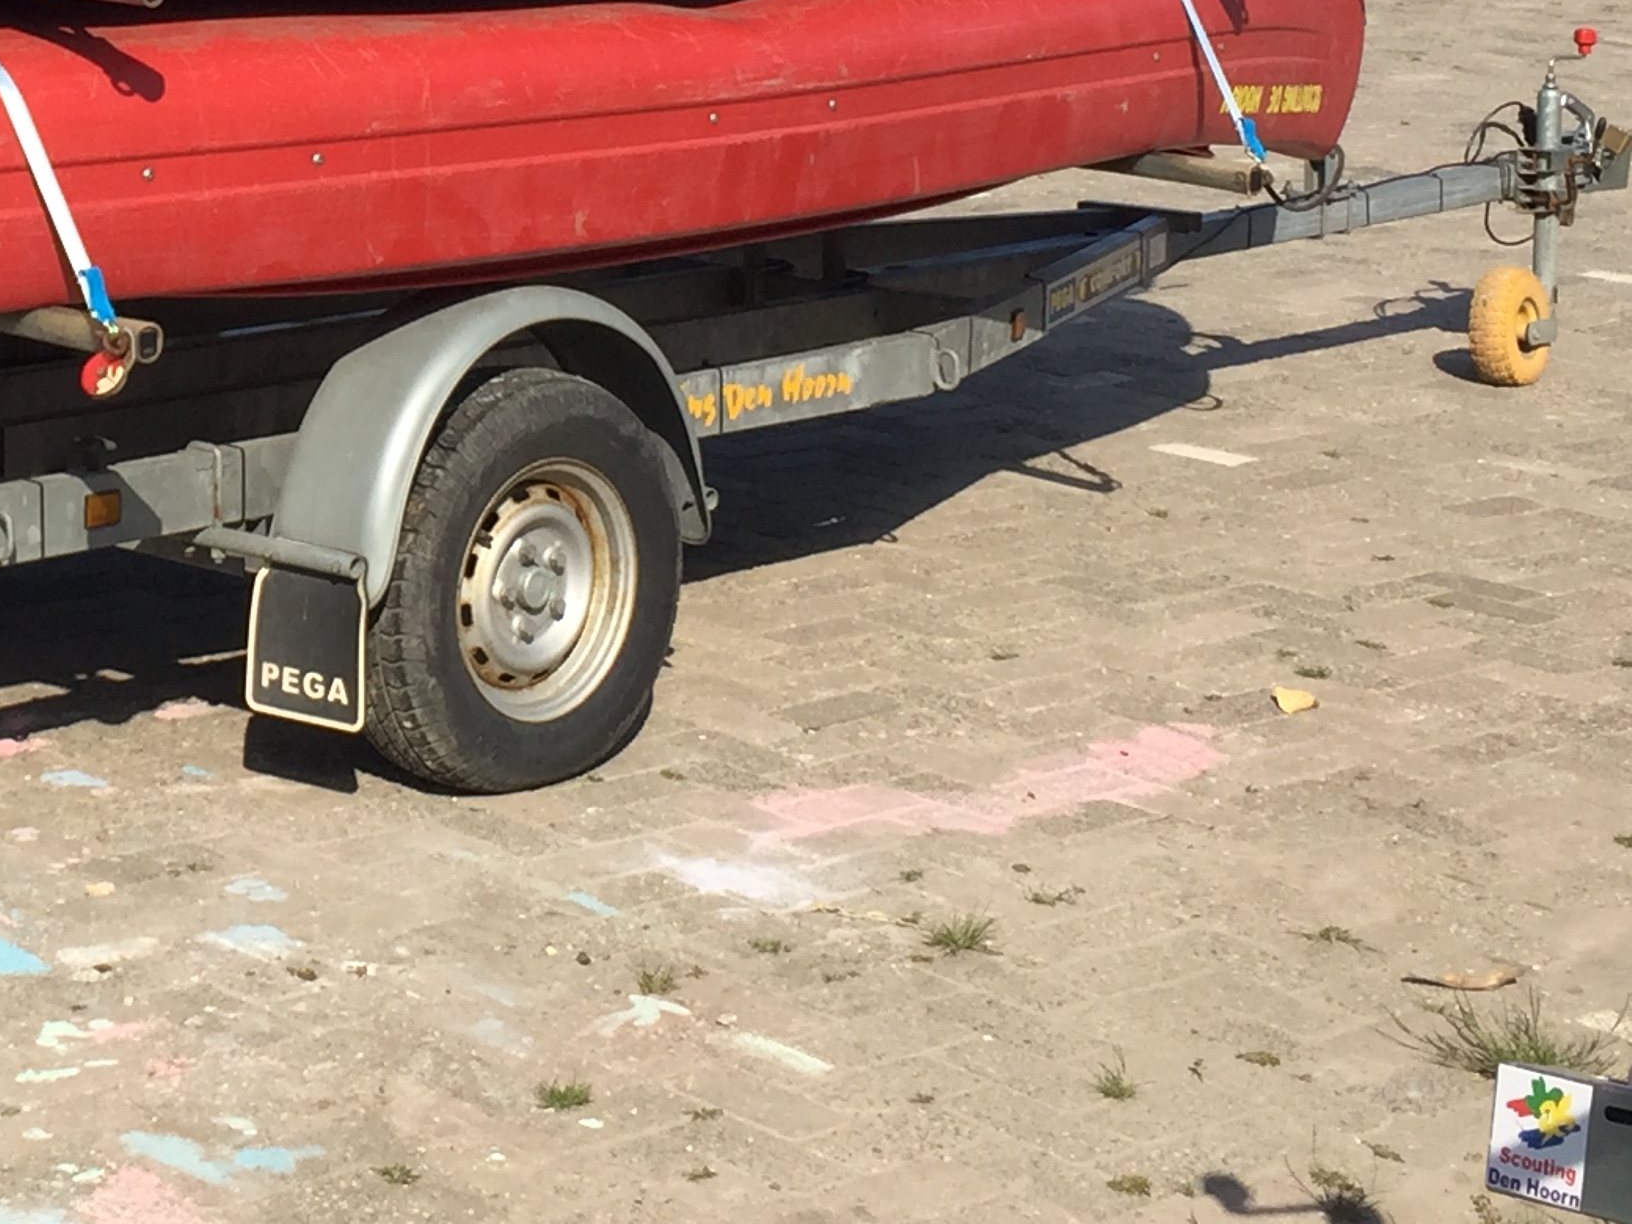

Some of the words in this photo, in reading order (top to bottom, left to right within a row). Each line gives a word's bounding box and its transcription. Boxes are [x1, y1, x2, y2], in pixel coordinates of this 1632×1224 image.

[721, 383, 773, 420] Den
[260, 660, 350, 706] PEGA
[1499, 1146, 1576, 1187] Scouting
[1488, 1167, 1522, 1191] Den
[1526, 1177, 1580, 1208] Hoorn
